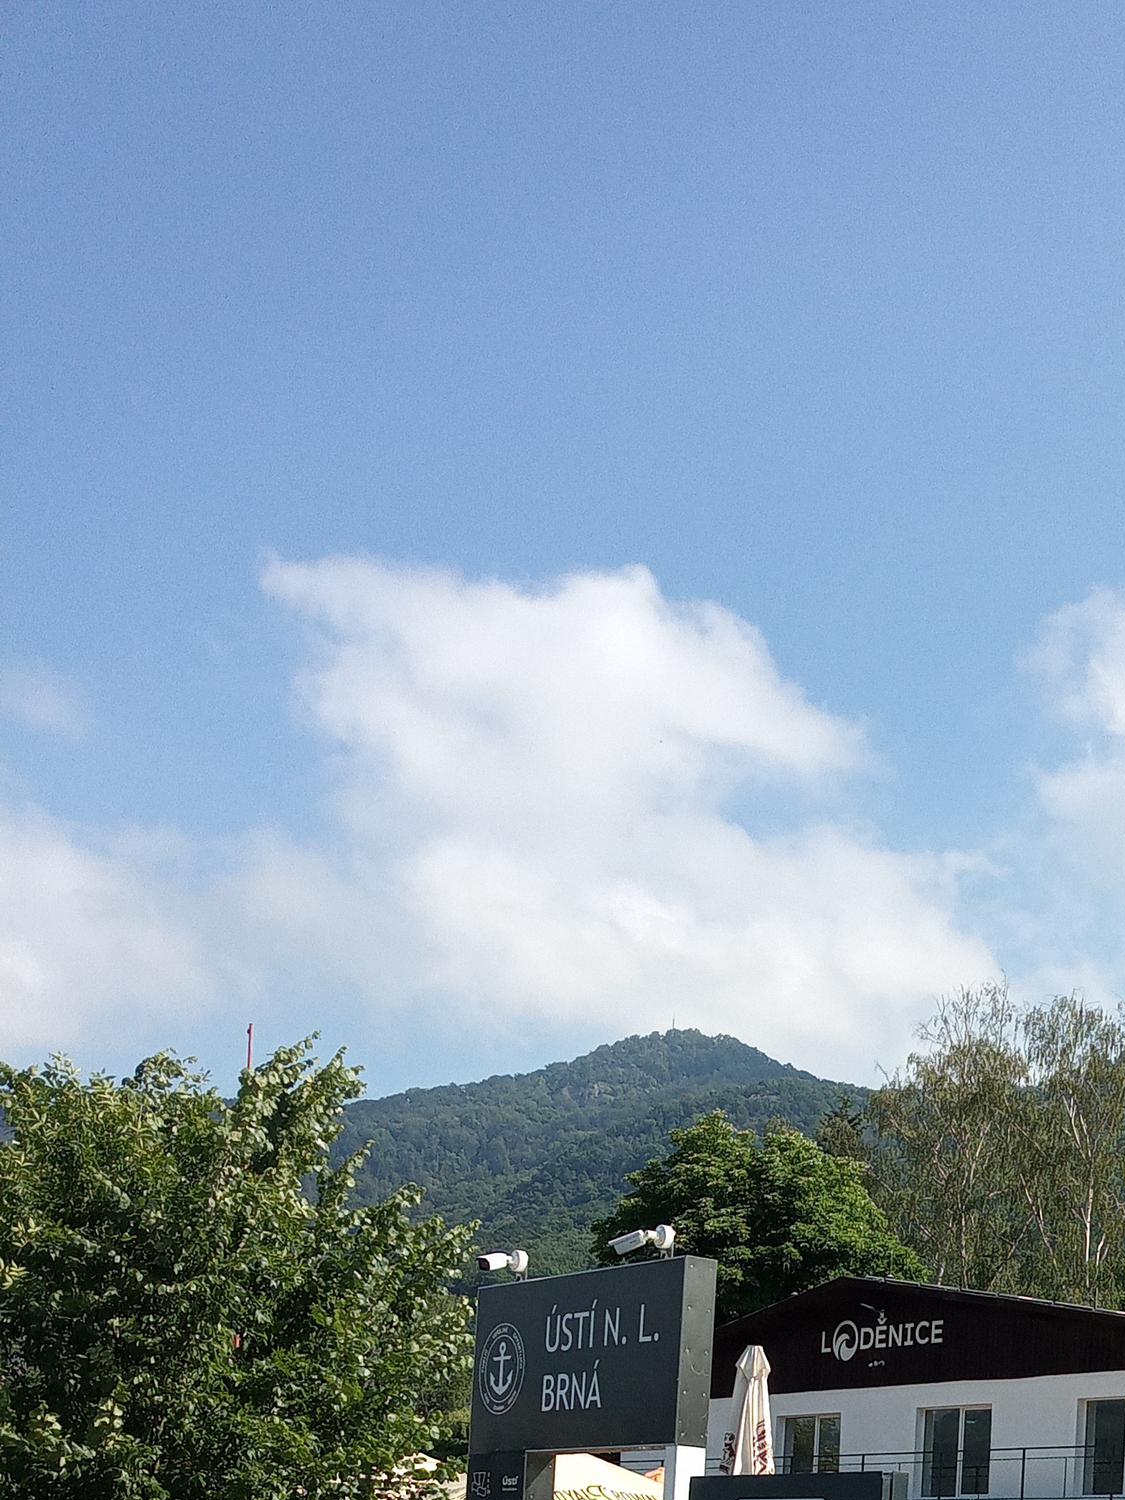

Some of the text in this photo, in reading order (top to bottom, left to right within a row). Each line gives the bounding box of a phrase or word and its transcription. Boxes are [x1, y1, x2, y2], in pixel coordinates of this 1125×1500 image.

[545, 1299, 598, 1353] ÚSTÍ
[603, 1307, 627, 1347] N.
[638, 1303, 660, 1343] L.
[821, 1317, 944, 1362] LODĚNICE
[540, 1359, 602, 1412] BRNÁ
